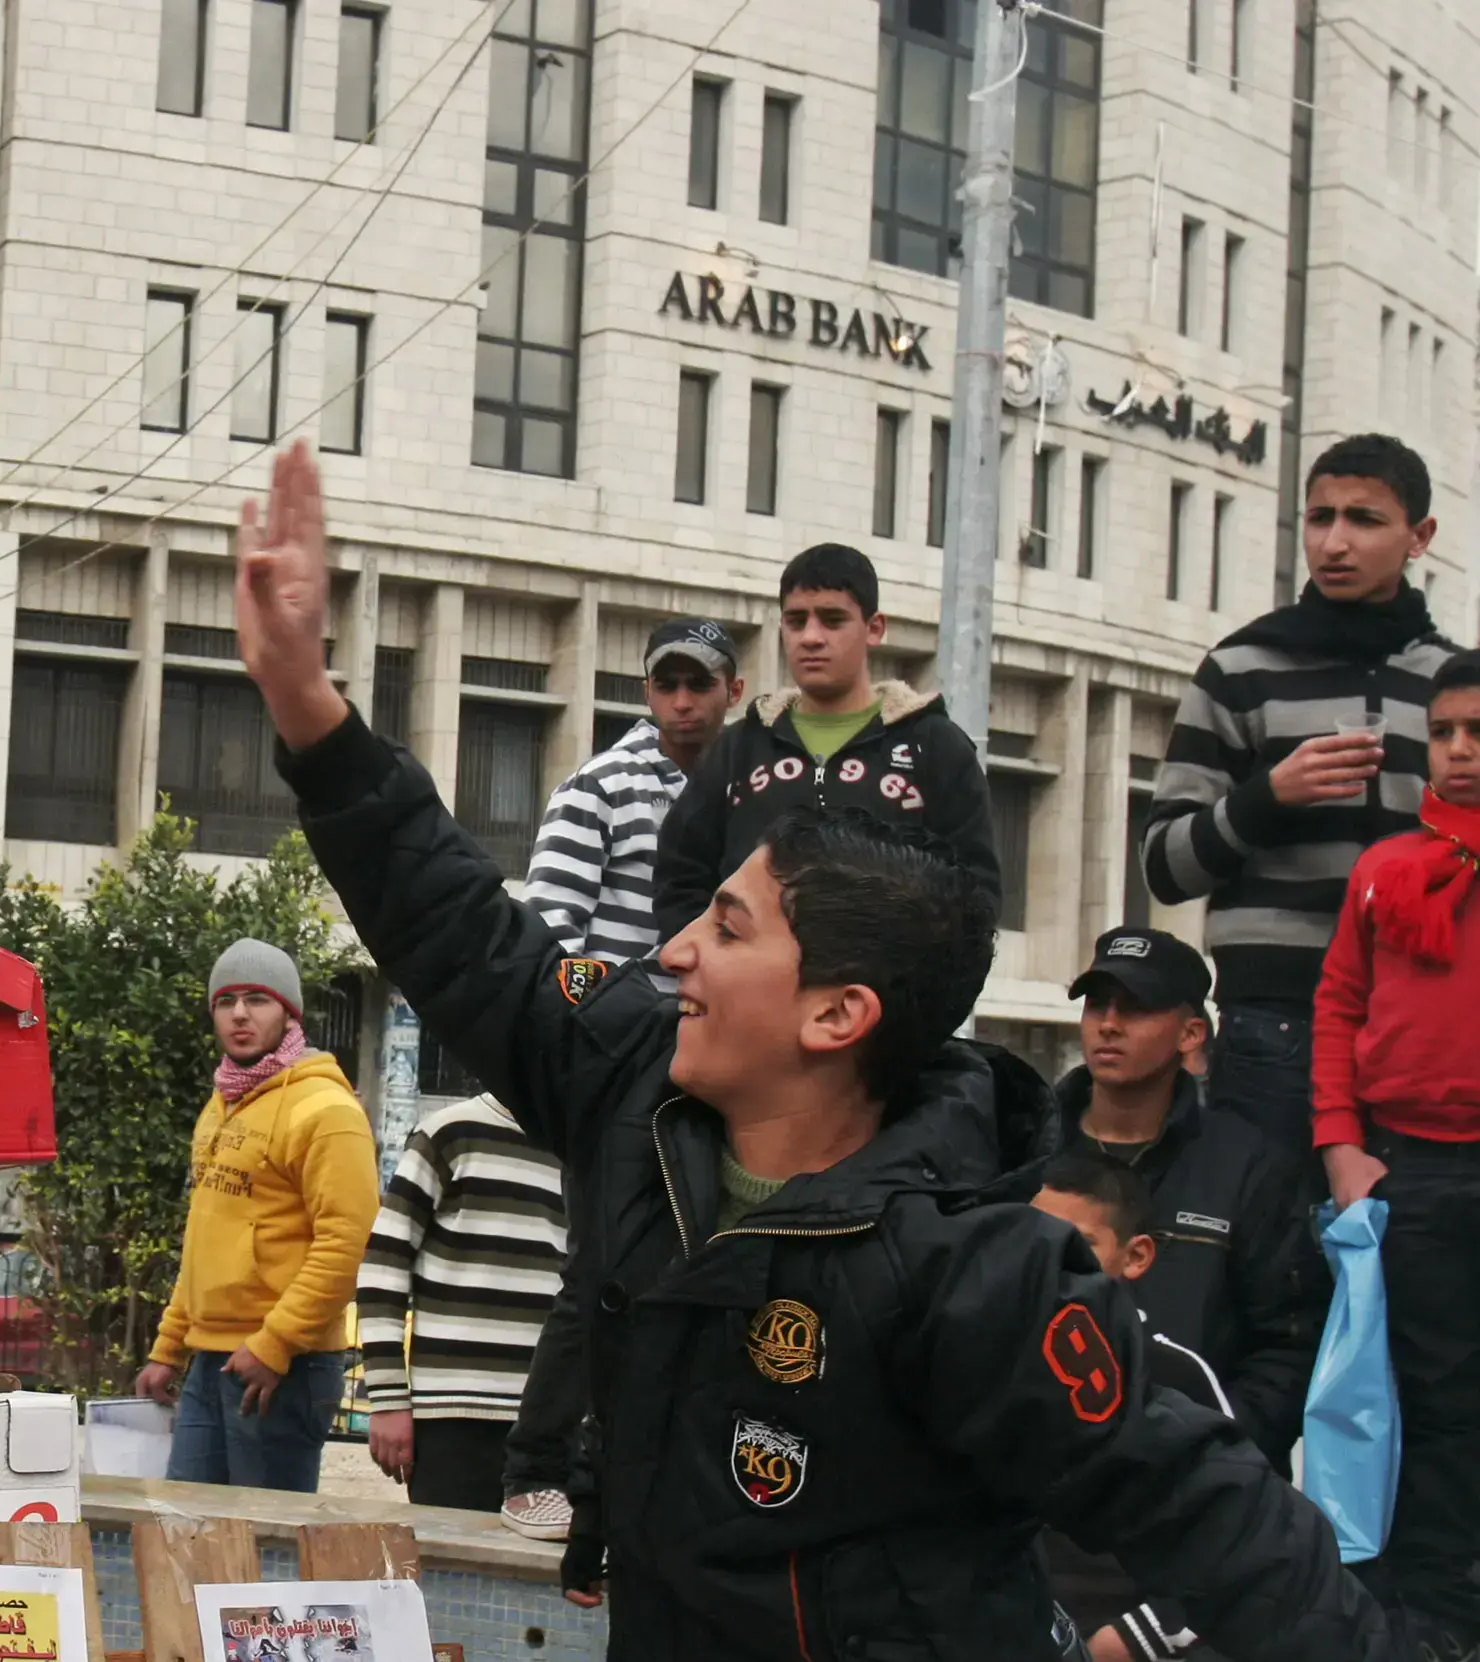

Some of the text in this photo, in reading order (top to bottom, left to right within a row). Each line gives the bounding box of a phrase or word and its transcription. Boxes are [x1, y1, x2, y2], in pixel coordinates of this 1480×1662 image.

[658, 270, 933, 372] ARAB BANK
[742, 1445, 792, 1495] K9
